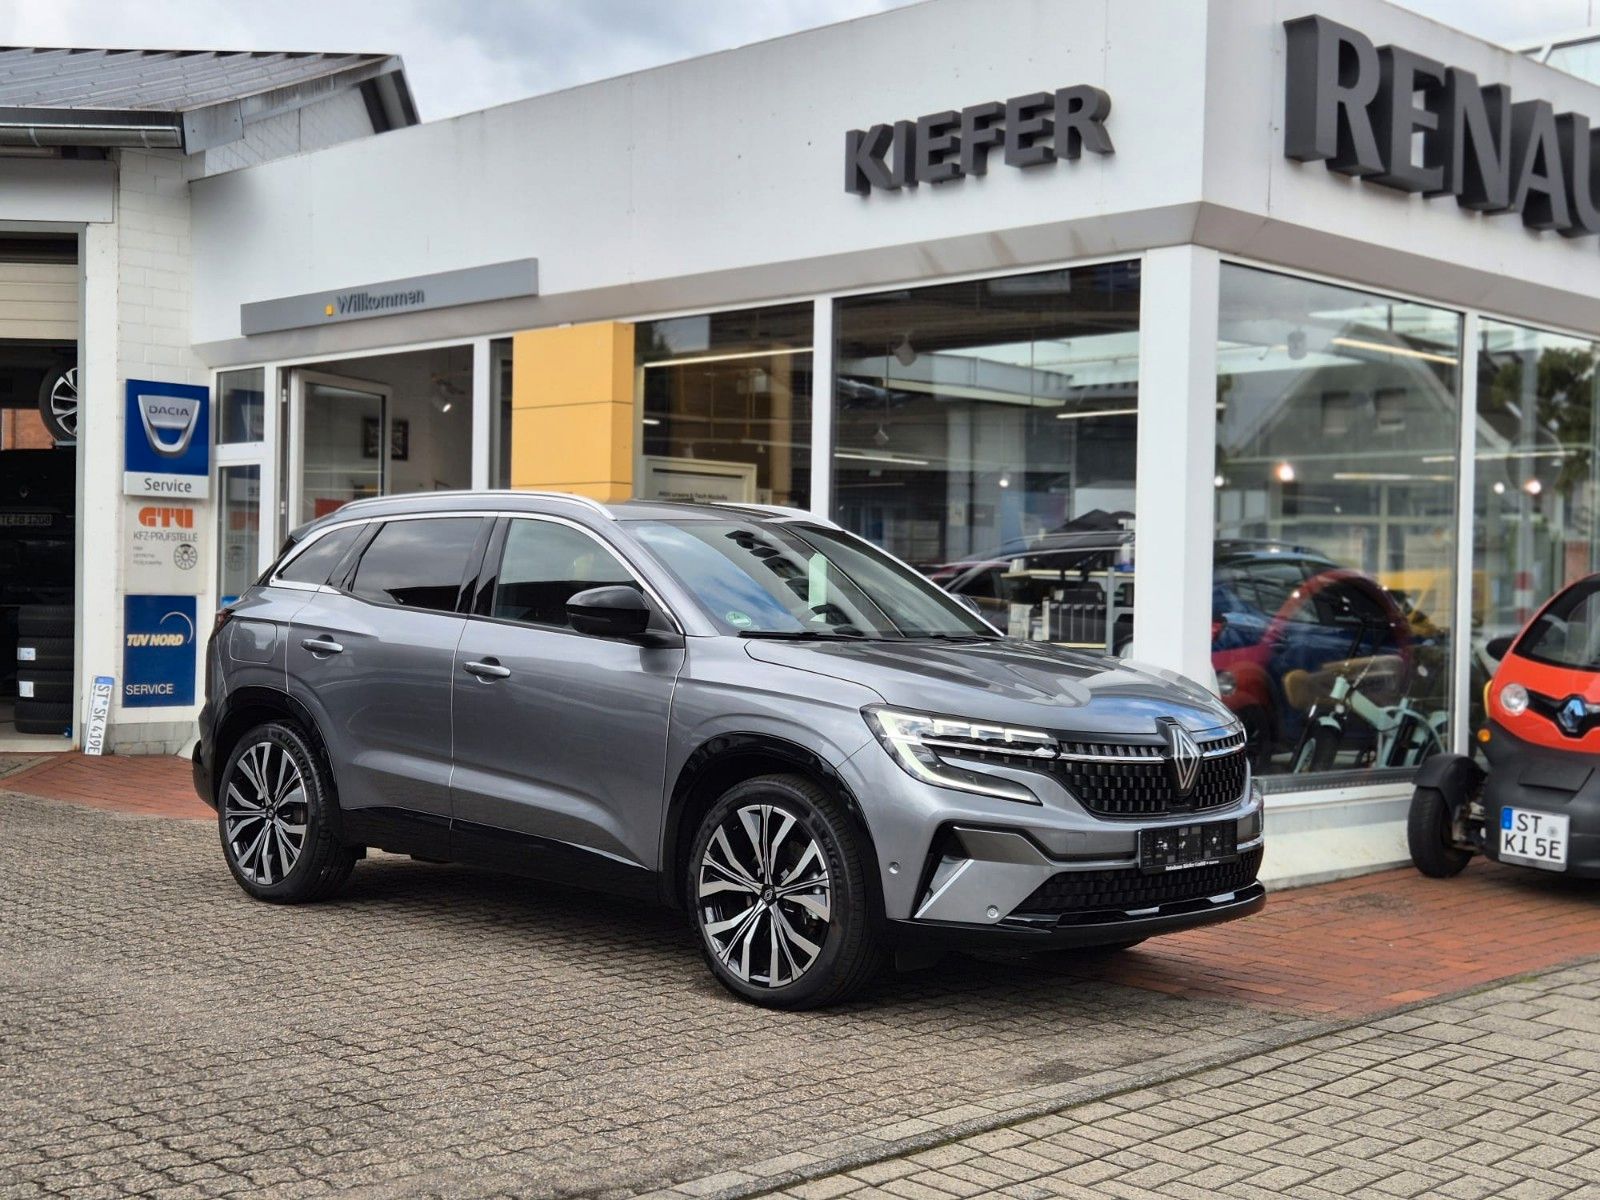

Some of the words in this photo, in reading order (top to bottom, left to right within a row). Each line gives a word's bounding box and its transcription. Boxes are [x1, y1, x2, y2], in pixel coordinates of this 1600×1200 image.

[845, 84, 1115, 196] KIEFER
[337, 289, 425, 314] Willkommen
[148, 405, 190, 416] DACIA
[144, 478, 192, 493] Service
[149, 634, 184, 646] NORD
[125, 683, 174, 695] SERVICE
[1516, 813, 1542, 834] ST
